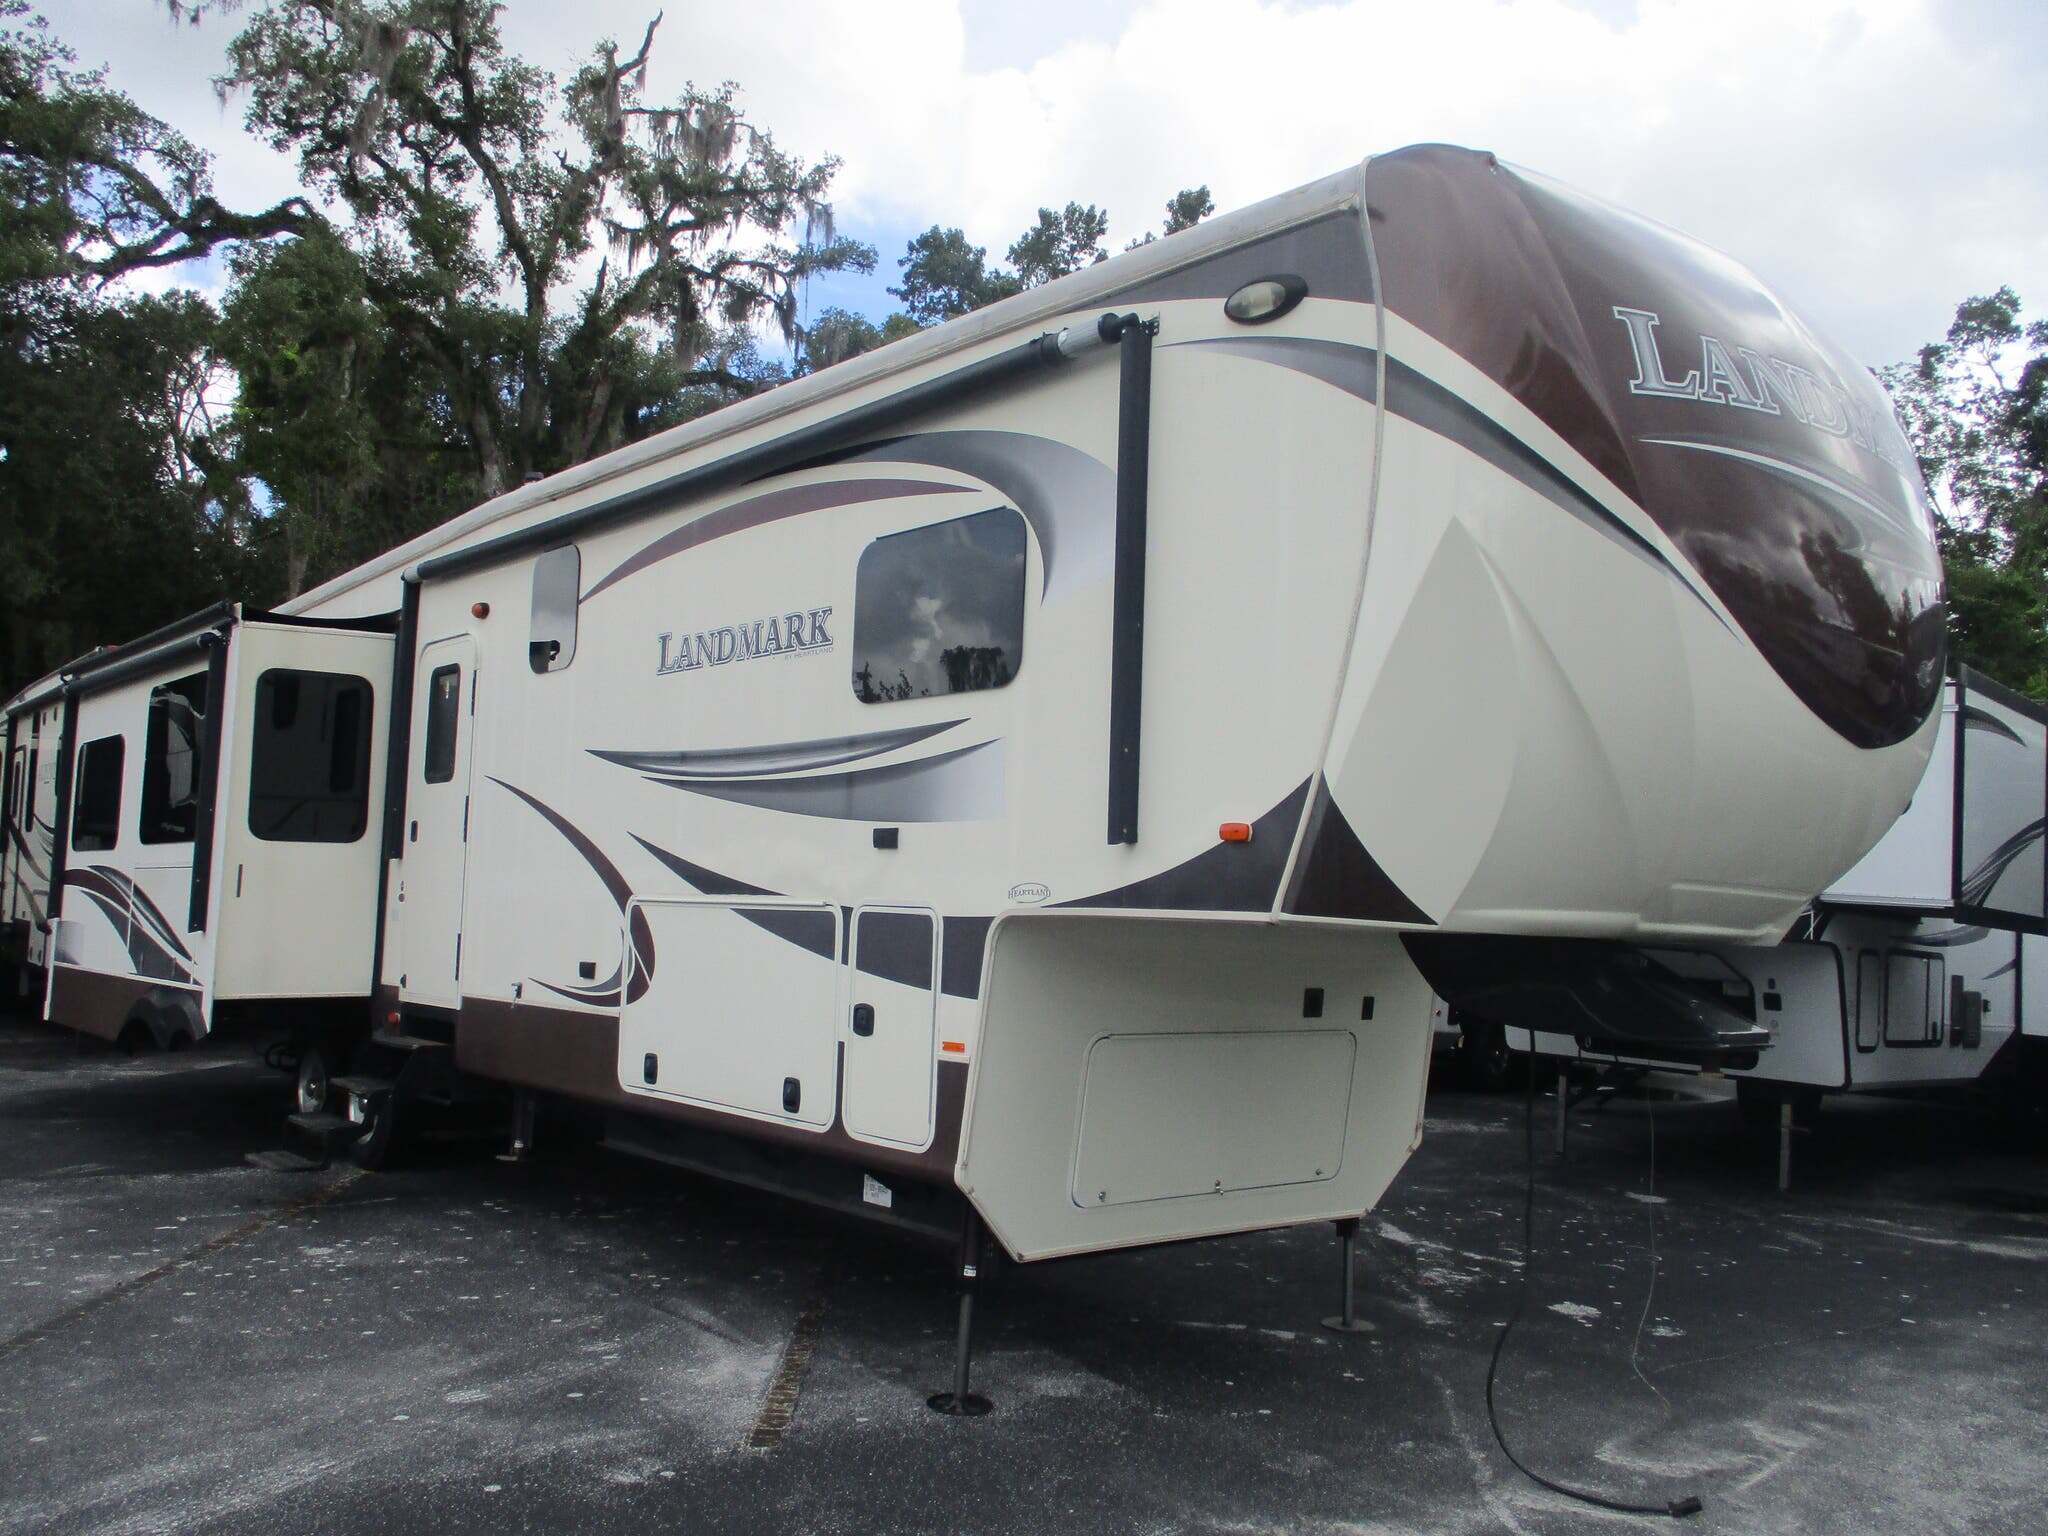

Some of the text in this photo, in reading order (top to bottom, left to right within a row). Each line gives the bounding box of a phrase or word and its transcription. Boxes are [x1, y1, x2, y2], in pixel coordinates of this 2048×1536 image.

[1612, 305, 1900, 466] LAND
[656, 606, 833, 676] LANDMARK
[1008, 888, 1051, 899] HEARTLAND
